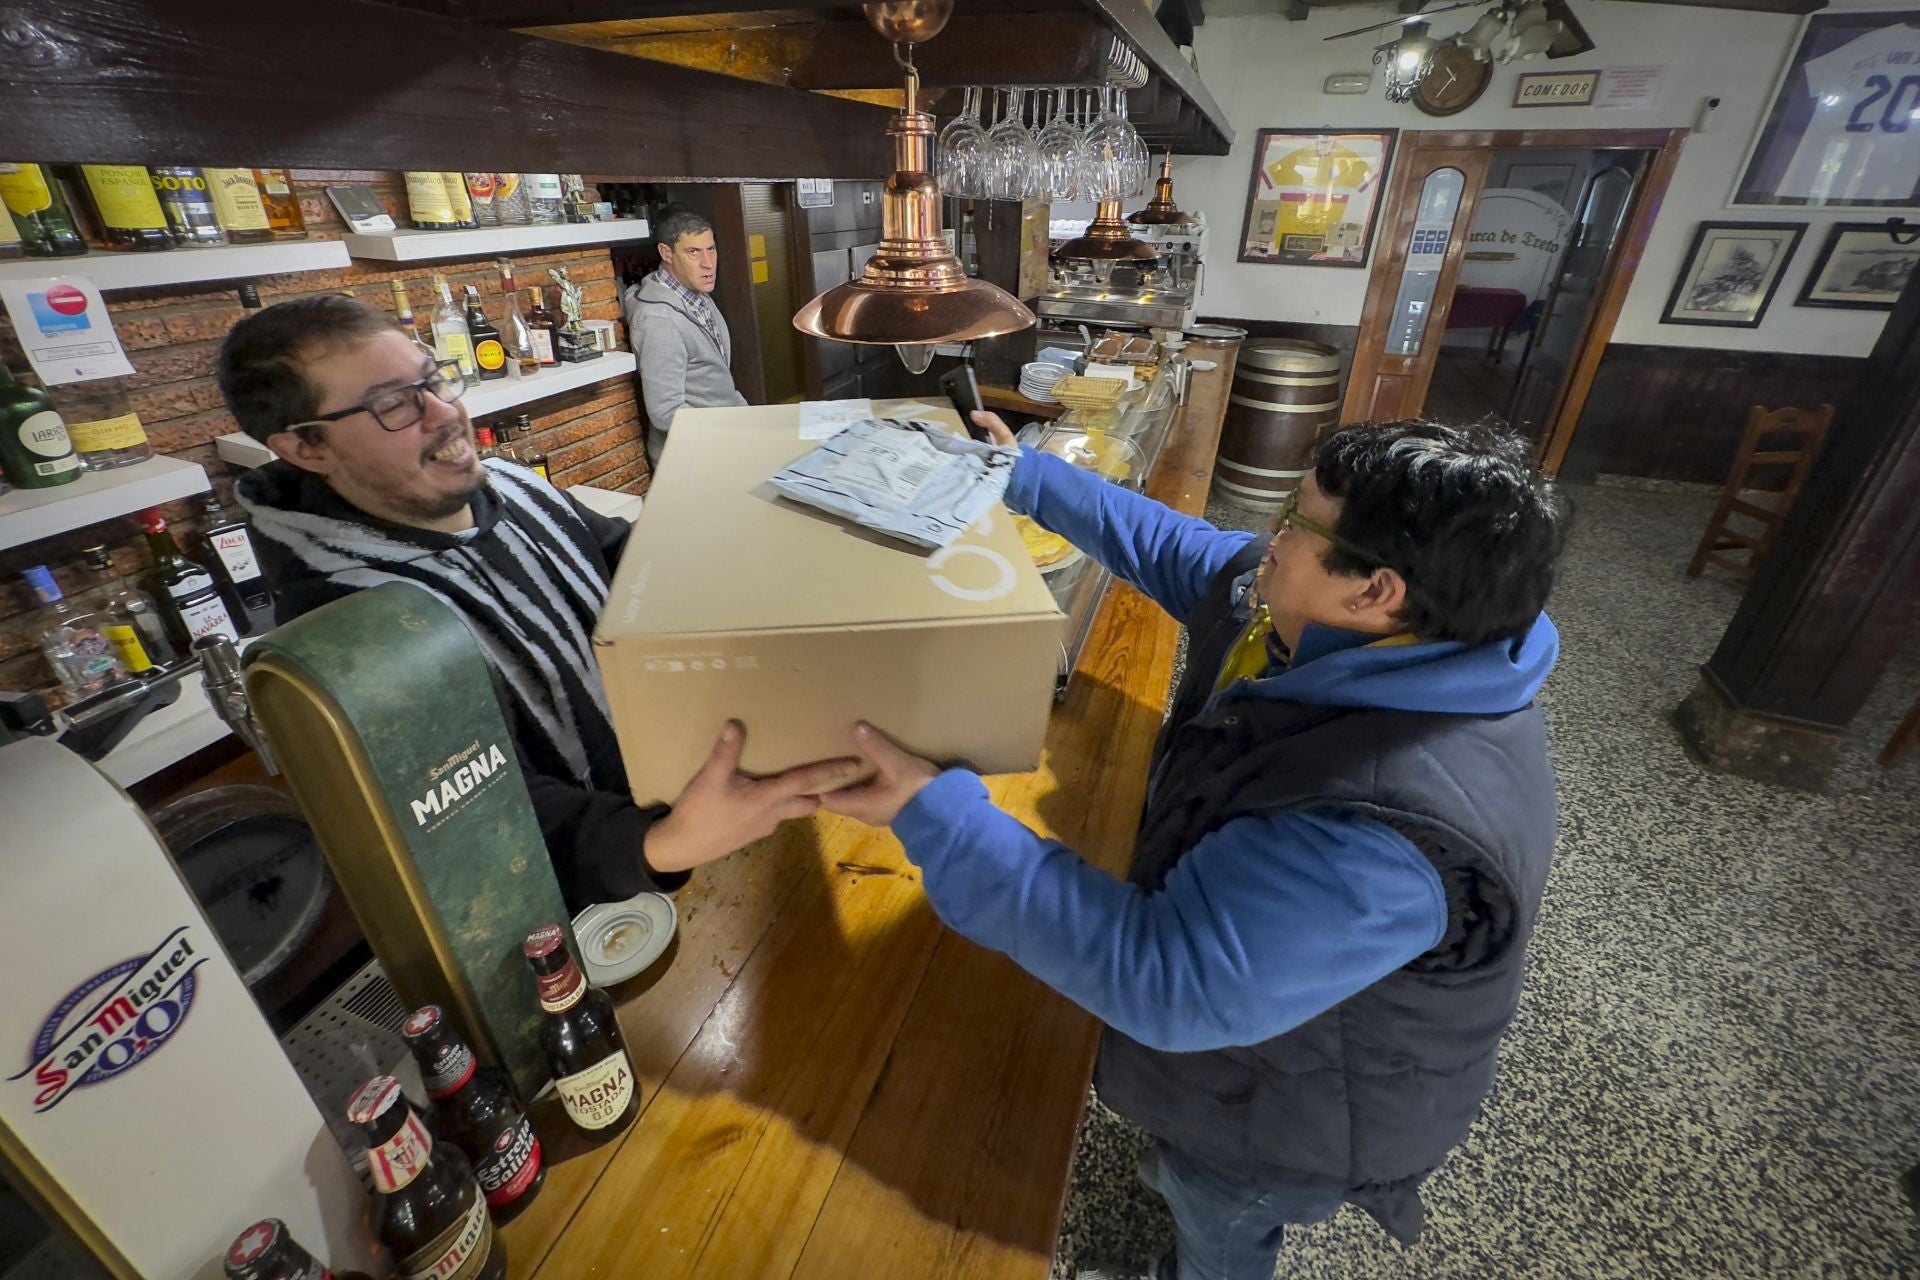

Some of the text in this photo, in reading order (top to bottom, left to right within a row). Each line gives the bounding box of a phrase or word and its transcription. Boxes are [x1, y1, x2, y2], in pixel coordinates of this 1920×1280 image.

[1523, 83, 1590, 97] COMEDOR
[1845, 74, 1920, 133] 20
[100, 169, 144, 177] PONCHE
[150, 175, 206, 191] SOTO
[1500, 228, 1517, 244] de
[192, 613, 228, 639] NAVARRA
[203, 615, 212, 624] LA
[410, 743, 508, 826] MAGNA
[562, 1067, 627, 1108] MAGNA
[575, 1086, 625, 1115] TOSTADA
[477, 1119, 530, 1181] Estrella
[484, 1132, 535, 1191] Galicia
